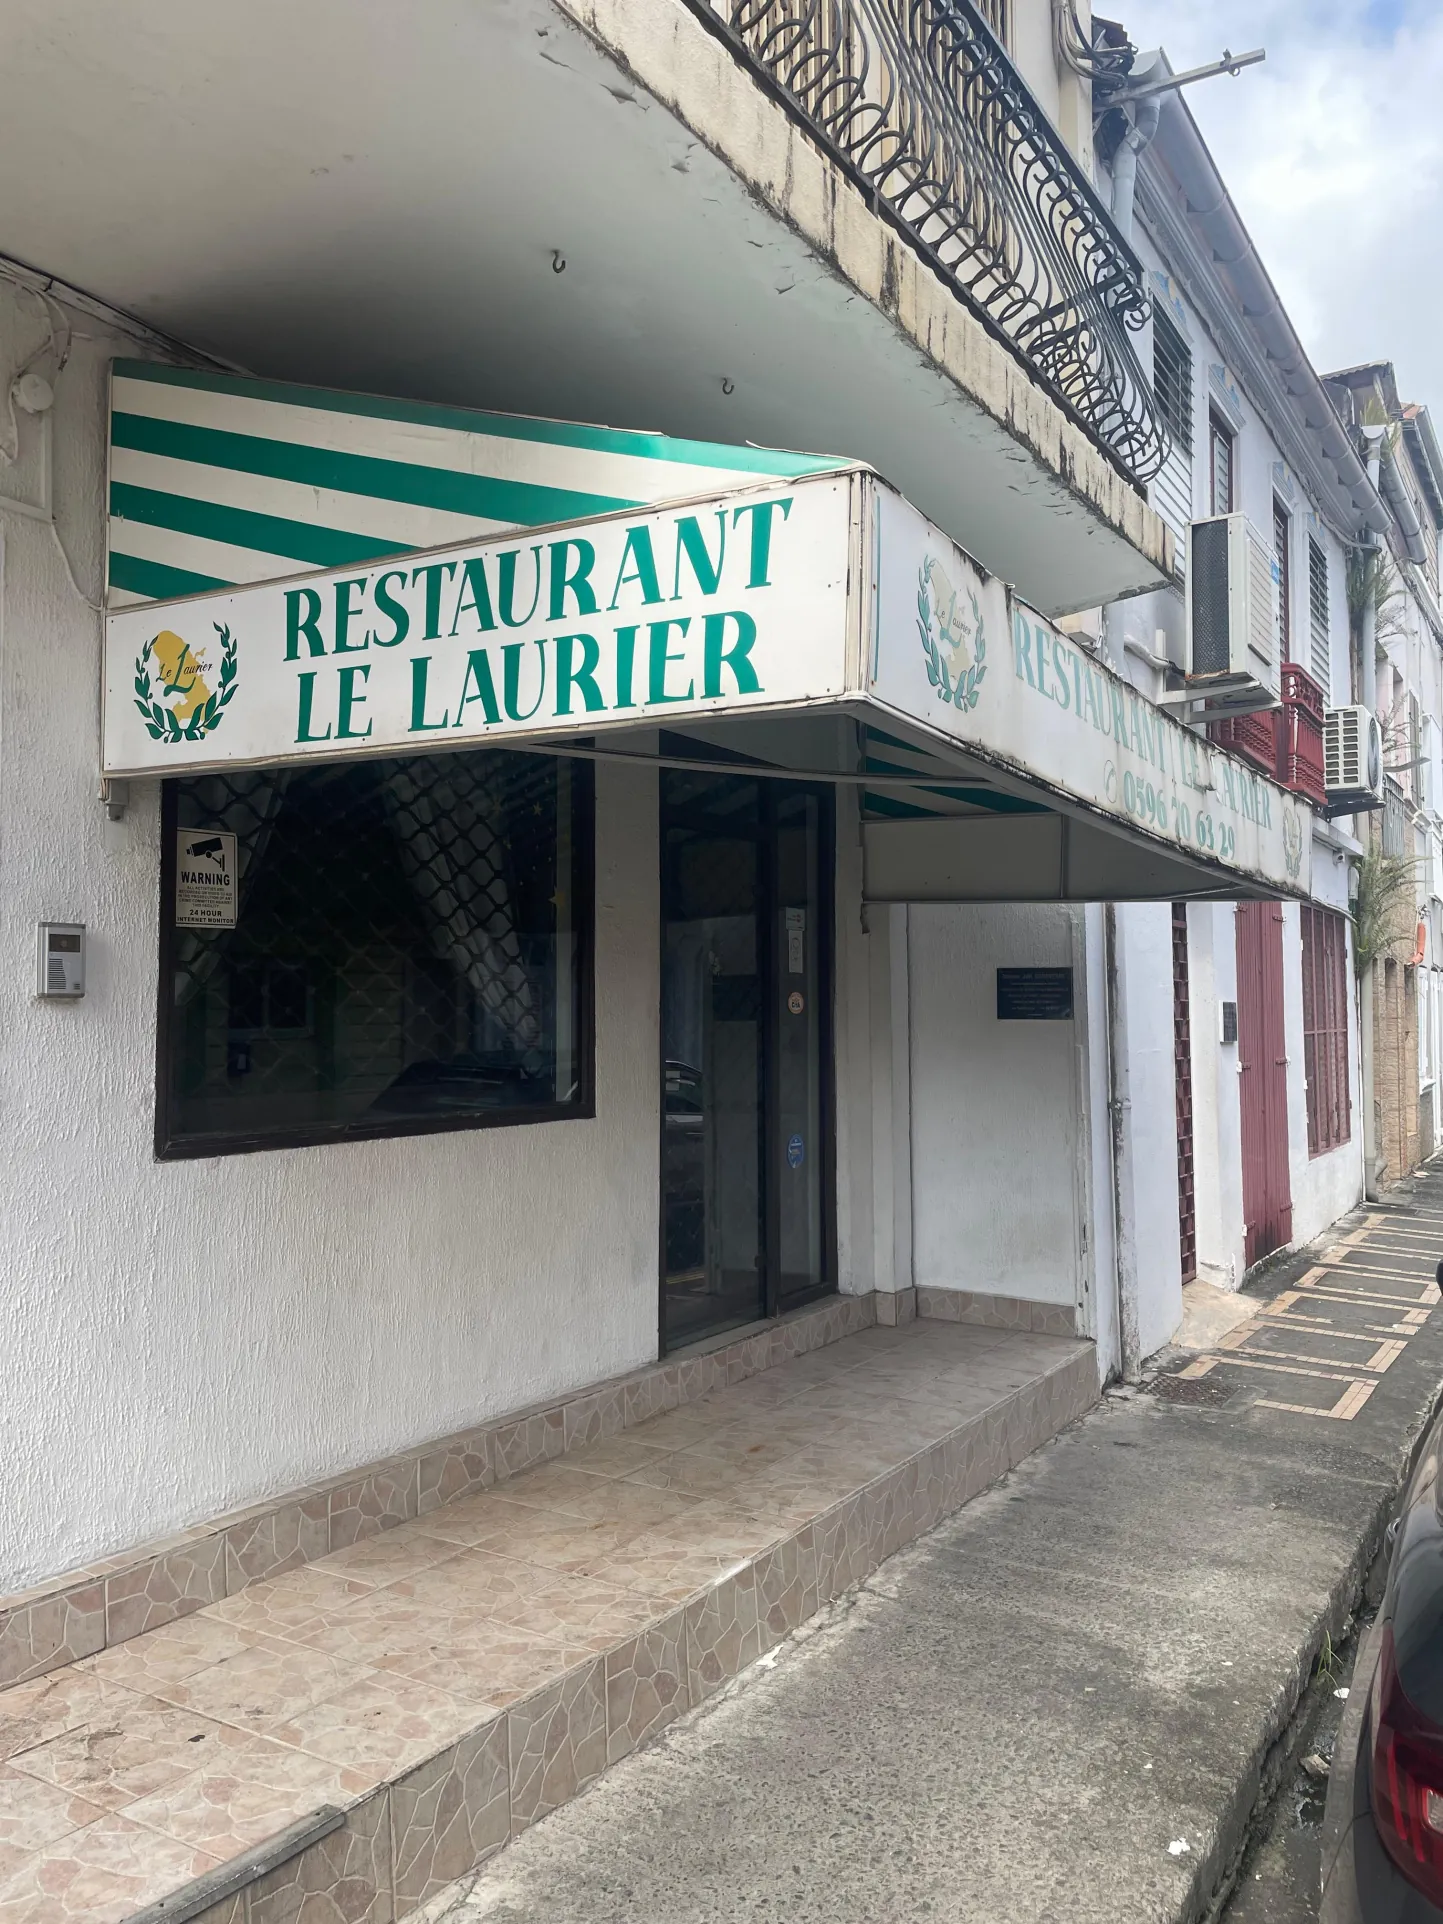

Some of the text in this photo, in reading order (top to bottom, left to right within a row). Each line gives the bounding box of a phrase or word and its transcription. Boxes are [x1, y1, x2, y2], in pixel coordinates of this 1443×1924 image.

[282, 497, 794, 662] RESTAURANT
[155, 643, 213, 697] Le Laurier
[294, 610, 765, 744] LE LAURIER
[1013, 607, 1166, 775] RESTAURANT
[1215, 762, 1272, 831] AURIER
[1123, 770, 1235, 860] 0596 70 63 29
[181, 871, 230, 886] WARNING
